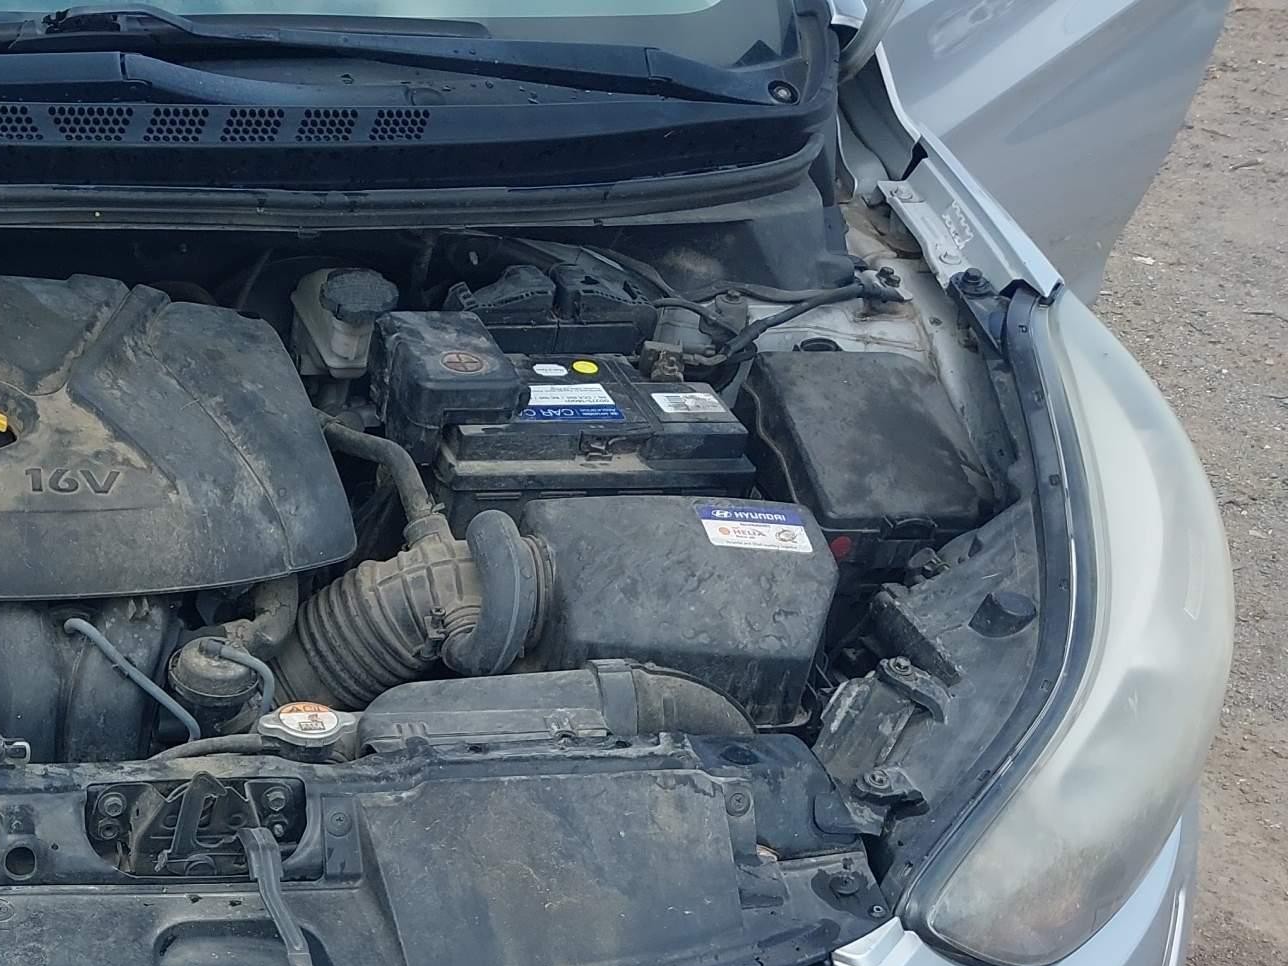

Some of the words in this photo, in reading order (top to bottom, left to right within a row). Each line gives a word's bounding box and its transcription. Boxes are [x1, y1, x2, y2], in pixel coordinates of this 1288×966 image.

[540, 408, 574, 416] CAR
[24, 467, 121, 495] 16V
[733, 511, 786, 522] HYUNDAI
